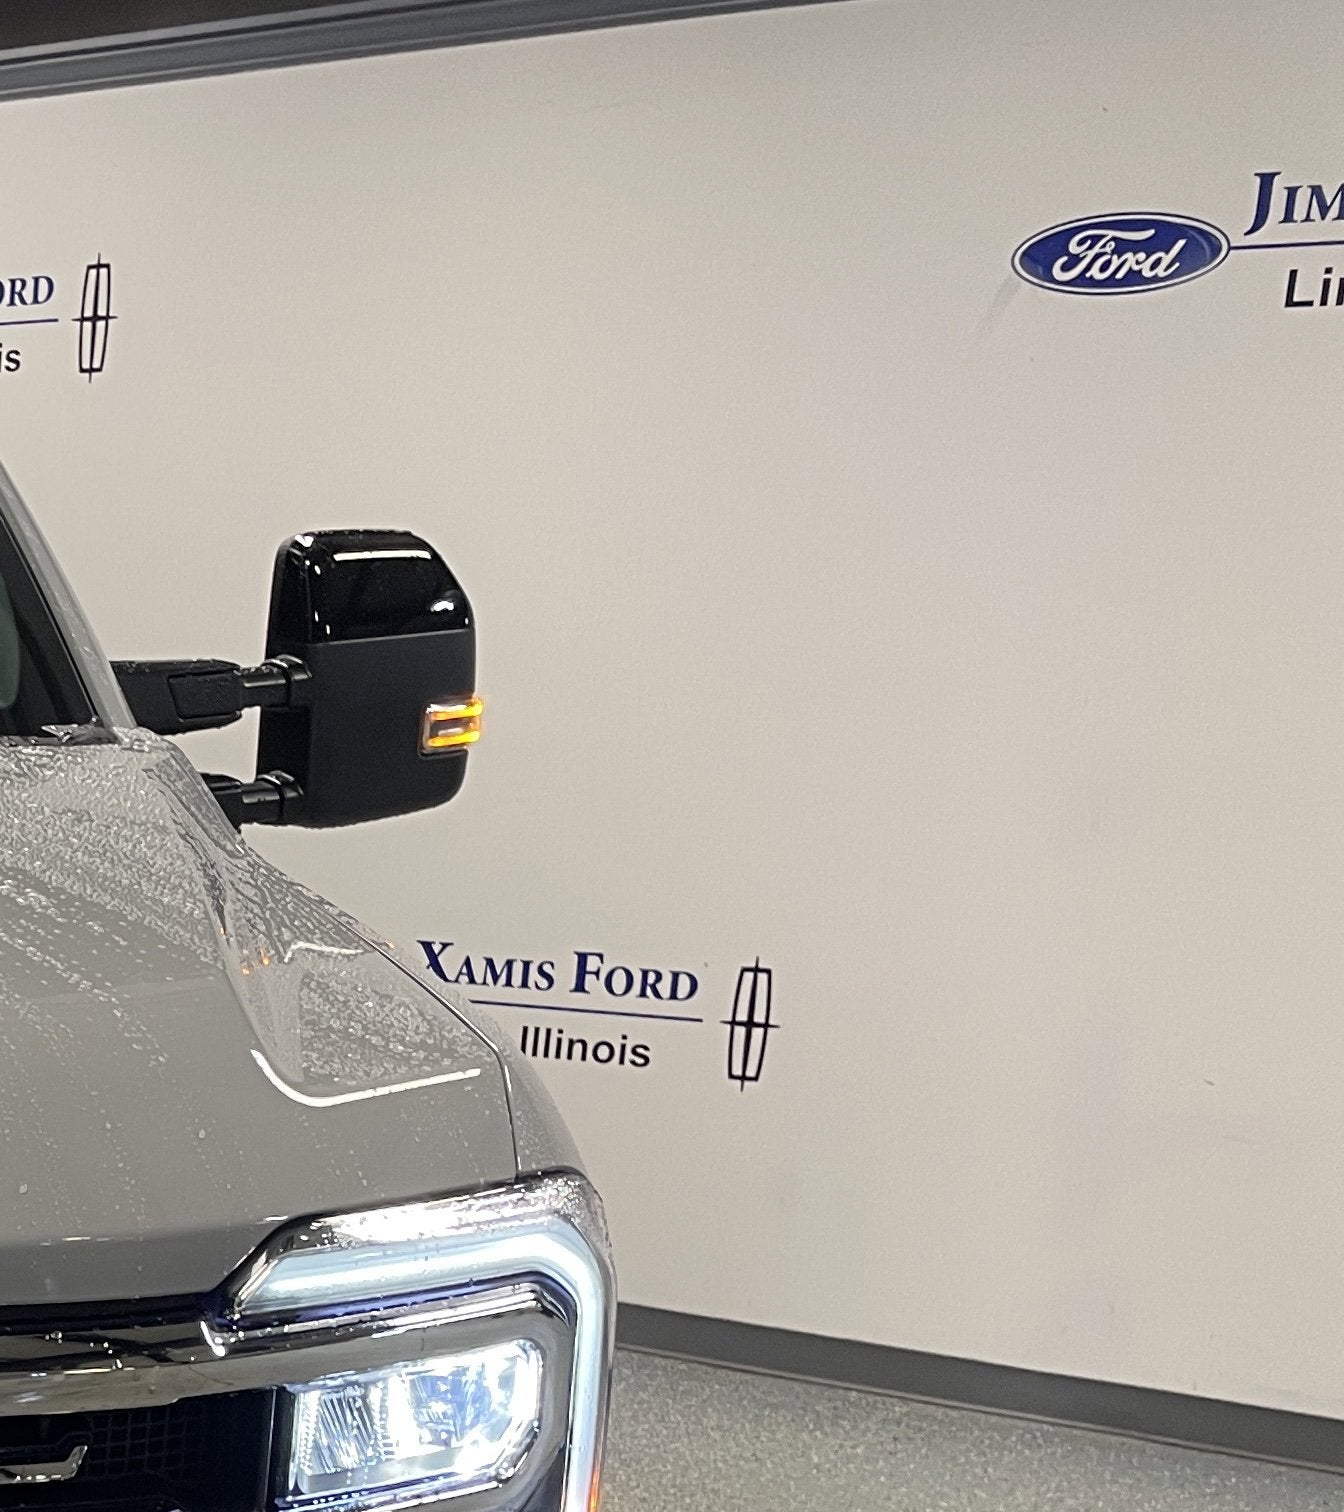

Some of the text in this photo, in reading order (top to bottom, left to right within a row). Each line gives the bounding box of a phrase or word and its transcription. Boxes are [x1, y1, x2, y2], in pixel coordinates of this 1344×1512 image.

[1051, 228, 1188, 282] Ford
[416, 939, 699, 1001] XAMIS FORD
